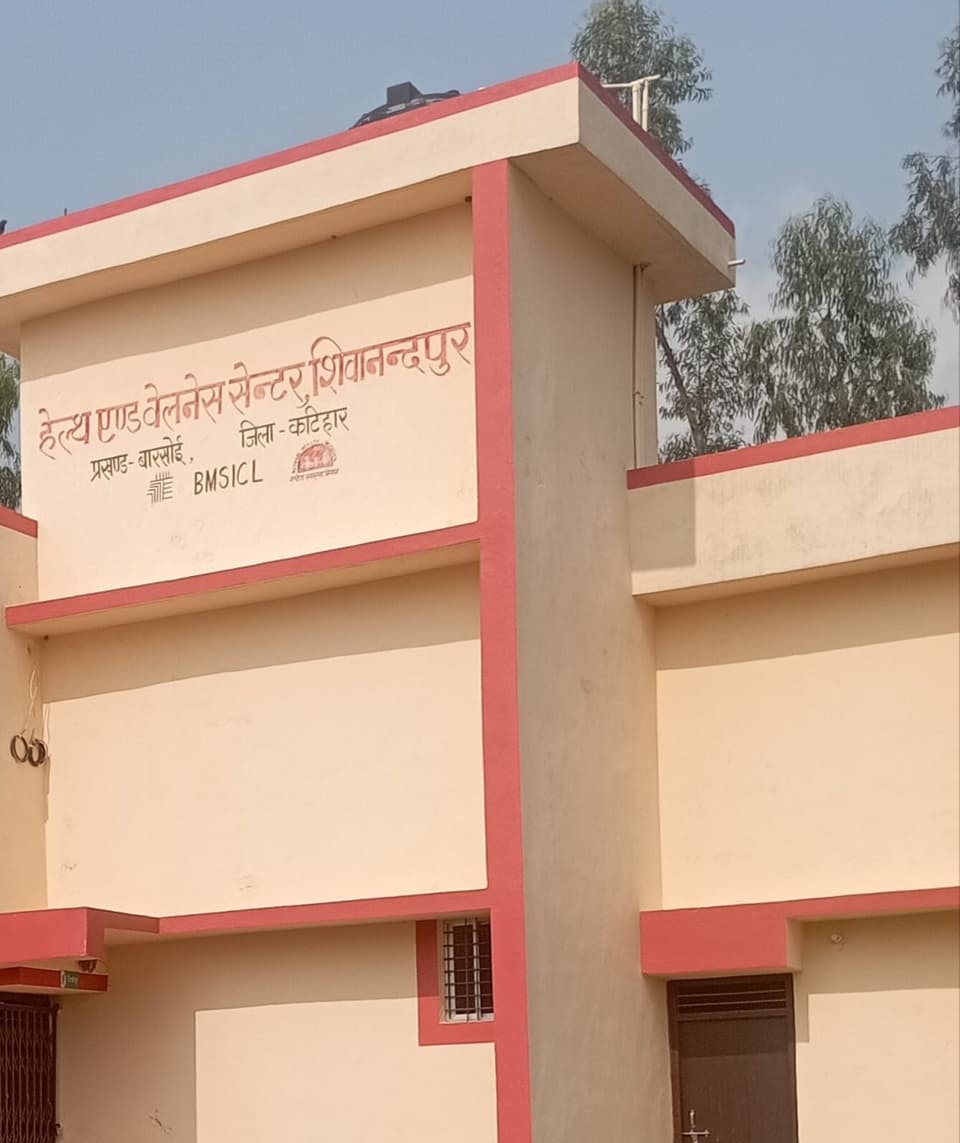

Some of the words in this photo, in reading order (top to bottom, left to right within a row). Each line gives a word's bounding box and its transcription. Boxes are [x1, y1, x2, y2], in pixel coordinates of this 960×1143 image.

[38, 407, 92, 460] हेल्थ
[95, 400, 142, 444] एण्ड
[142, 372, 226, 433] वेलनेस
[308, 321, 472, 397] शिवानन्दपुर
[288, 405, 351, 437] कटिहार
[193, 459, 264, 496] BMSICL
